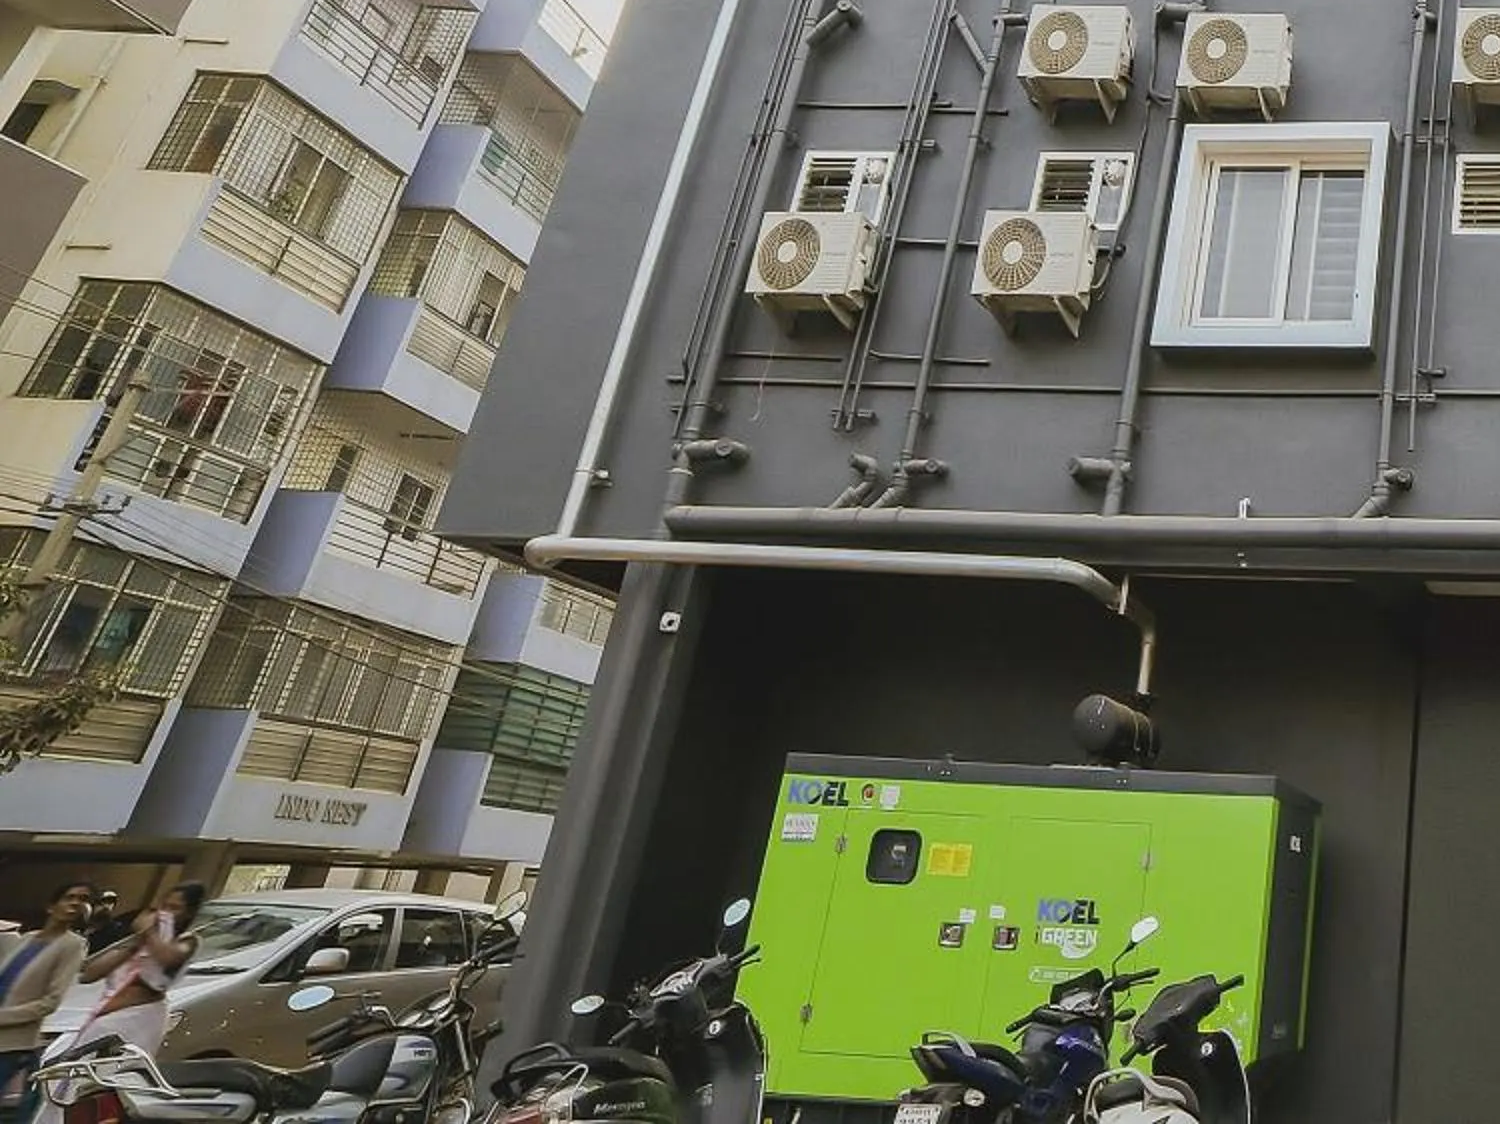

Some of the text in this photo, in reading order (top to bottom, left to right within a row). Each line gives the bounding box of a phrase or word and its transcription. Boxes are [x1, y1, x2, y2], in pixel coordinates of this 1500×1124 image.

[787, 780, 849, 807] KOEL
[321, 798, 367, 827] NEST
[1037, 899, 1099, 924] KOEL
